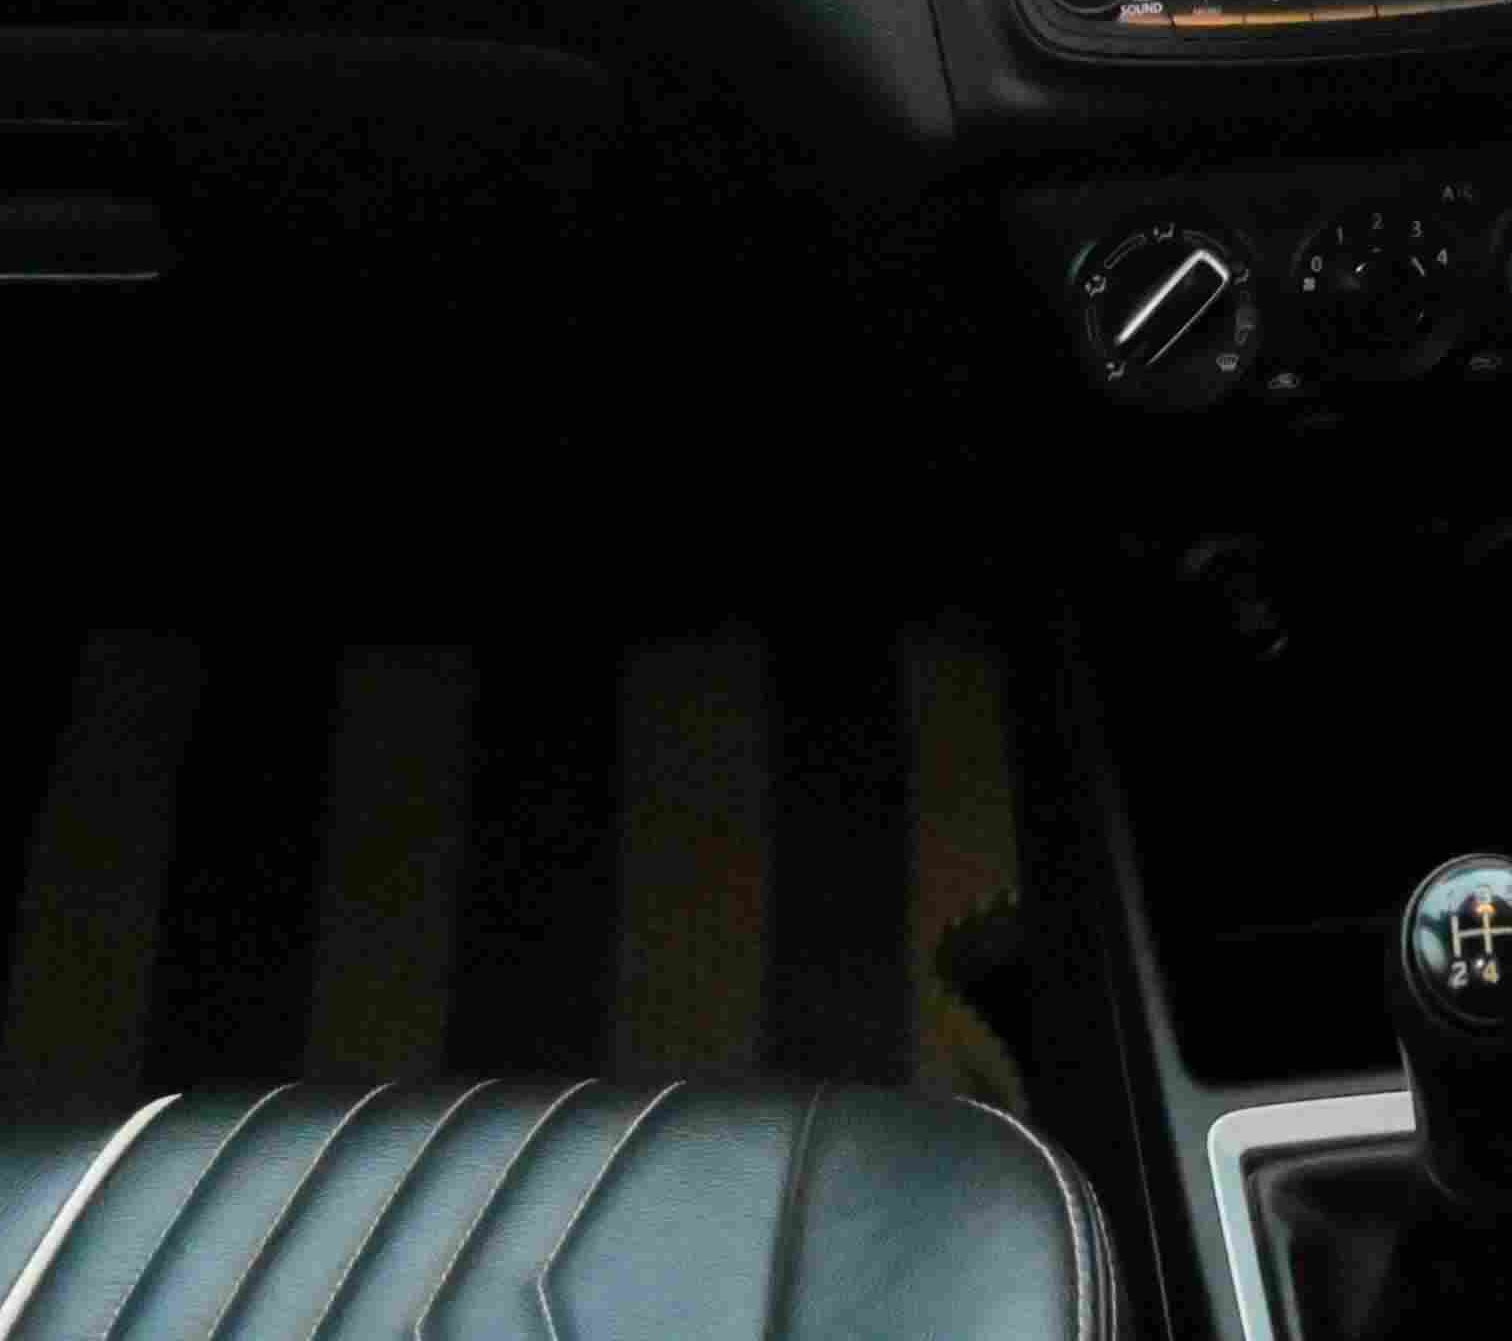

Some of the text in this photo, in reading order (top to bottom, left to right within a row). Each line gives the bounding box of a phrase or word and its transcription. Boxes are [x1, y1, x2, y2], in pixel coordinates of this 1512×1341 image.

[1119, 1, 1164, 18] SOUND
[1410, 220, 1423, 237] 3
[1435, 247, 1449, 268] 4
[1448, 960, 1469, 988] 2
[1483, 960, 1500, 984] 4
